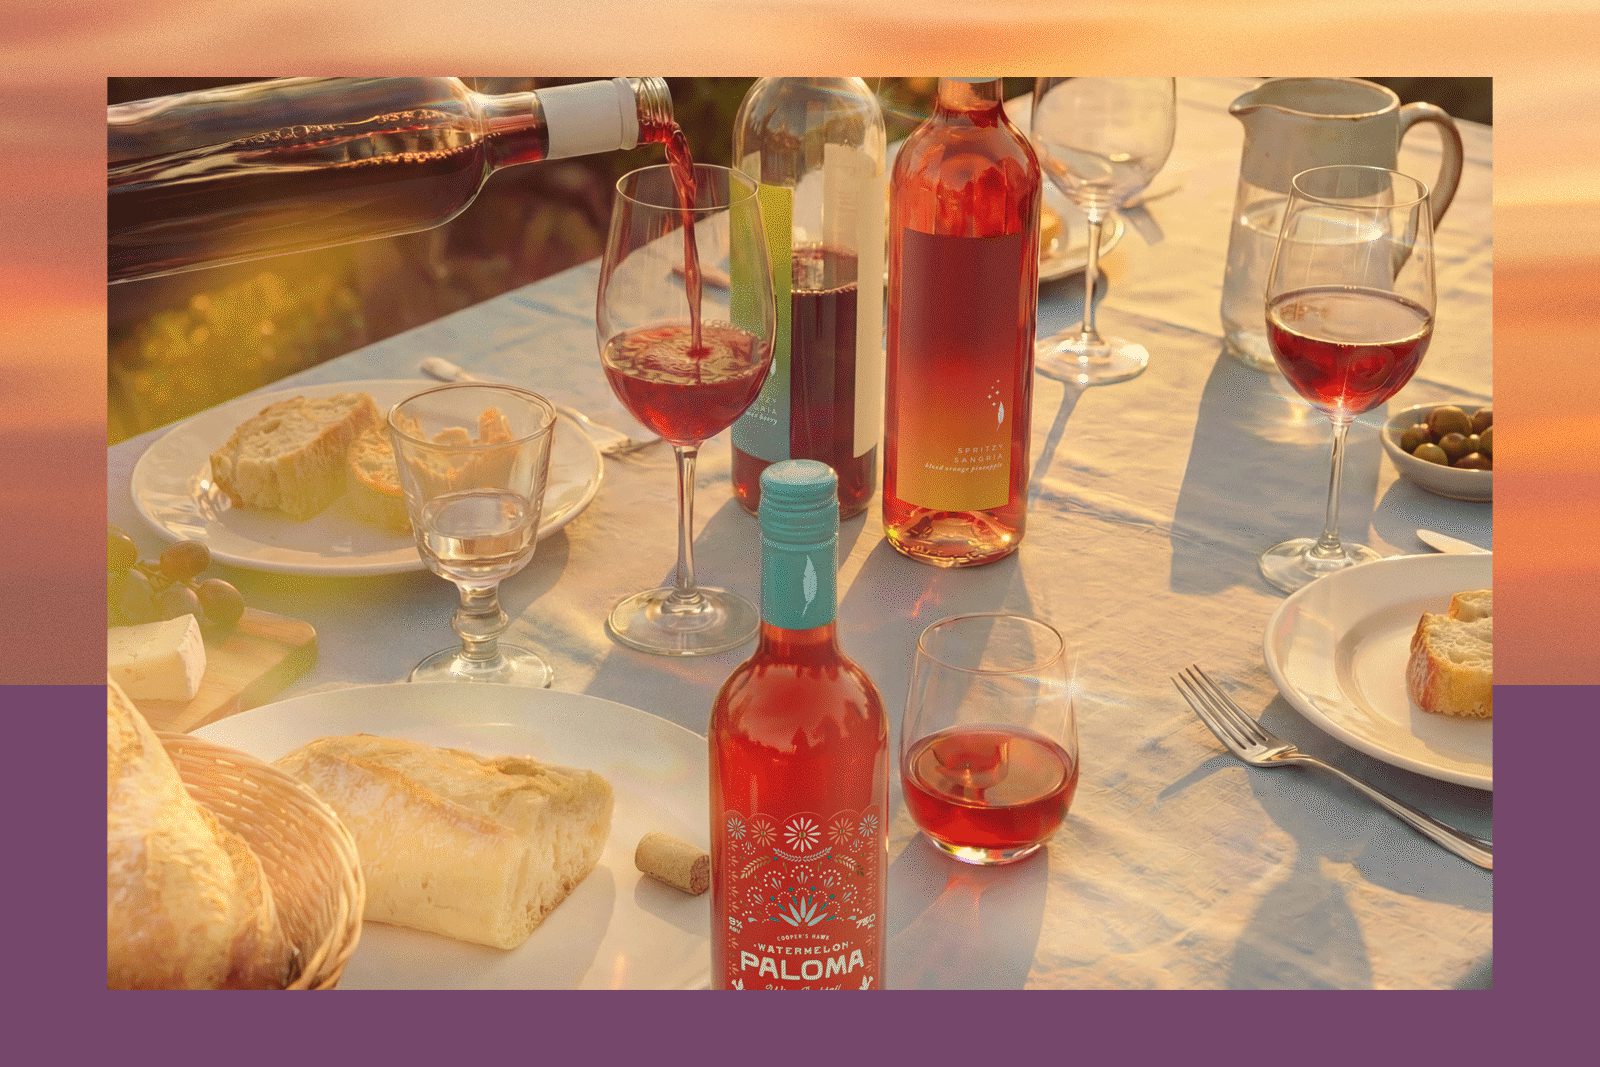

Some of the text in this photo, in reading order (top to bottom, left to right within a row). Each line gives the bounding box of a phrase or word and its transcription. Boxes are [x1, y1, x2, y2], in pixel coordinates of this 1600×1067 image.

[958, 444, 1003, 454] SPRITZY
[954, 454, 1003, 464] SANGRIA
[945, 466, 970, 474] orange
[757, 941, 849, 955] WATERMELON
[740, 948, 864, 981] PALOMA
